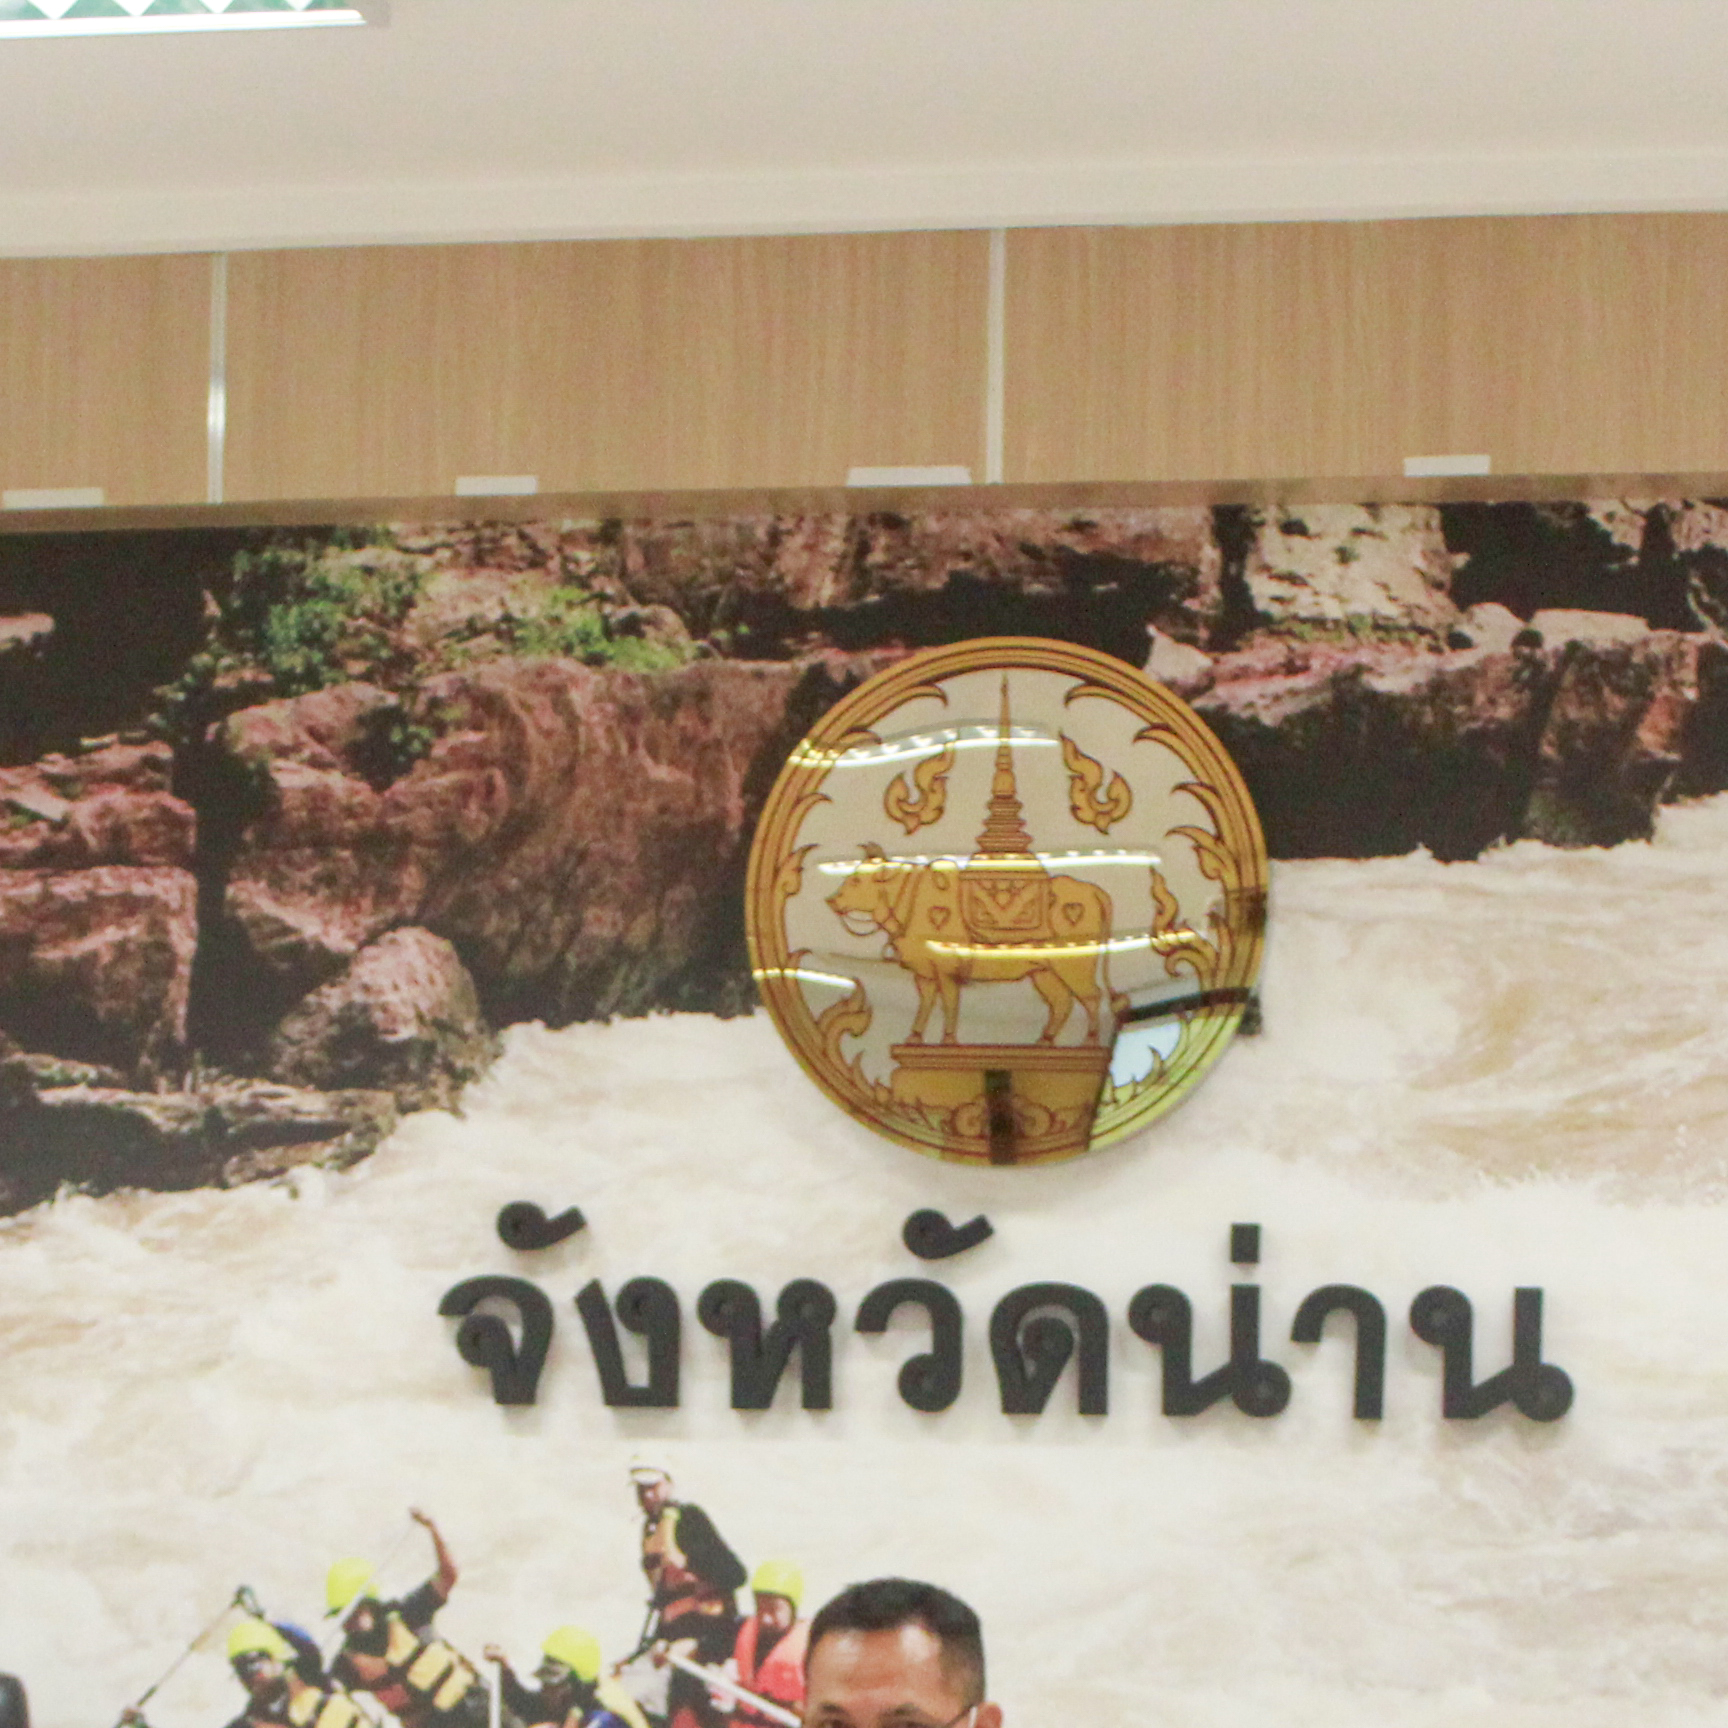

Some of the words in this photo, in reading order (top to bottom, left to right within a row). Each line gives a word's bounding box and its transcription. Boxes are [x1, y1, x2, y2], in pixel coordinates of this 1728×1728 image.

[438, 1201, 1575, 1423] จังหวัดน่าน
